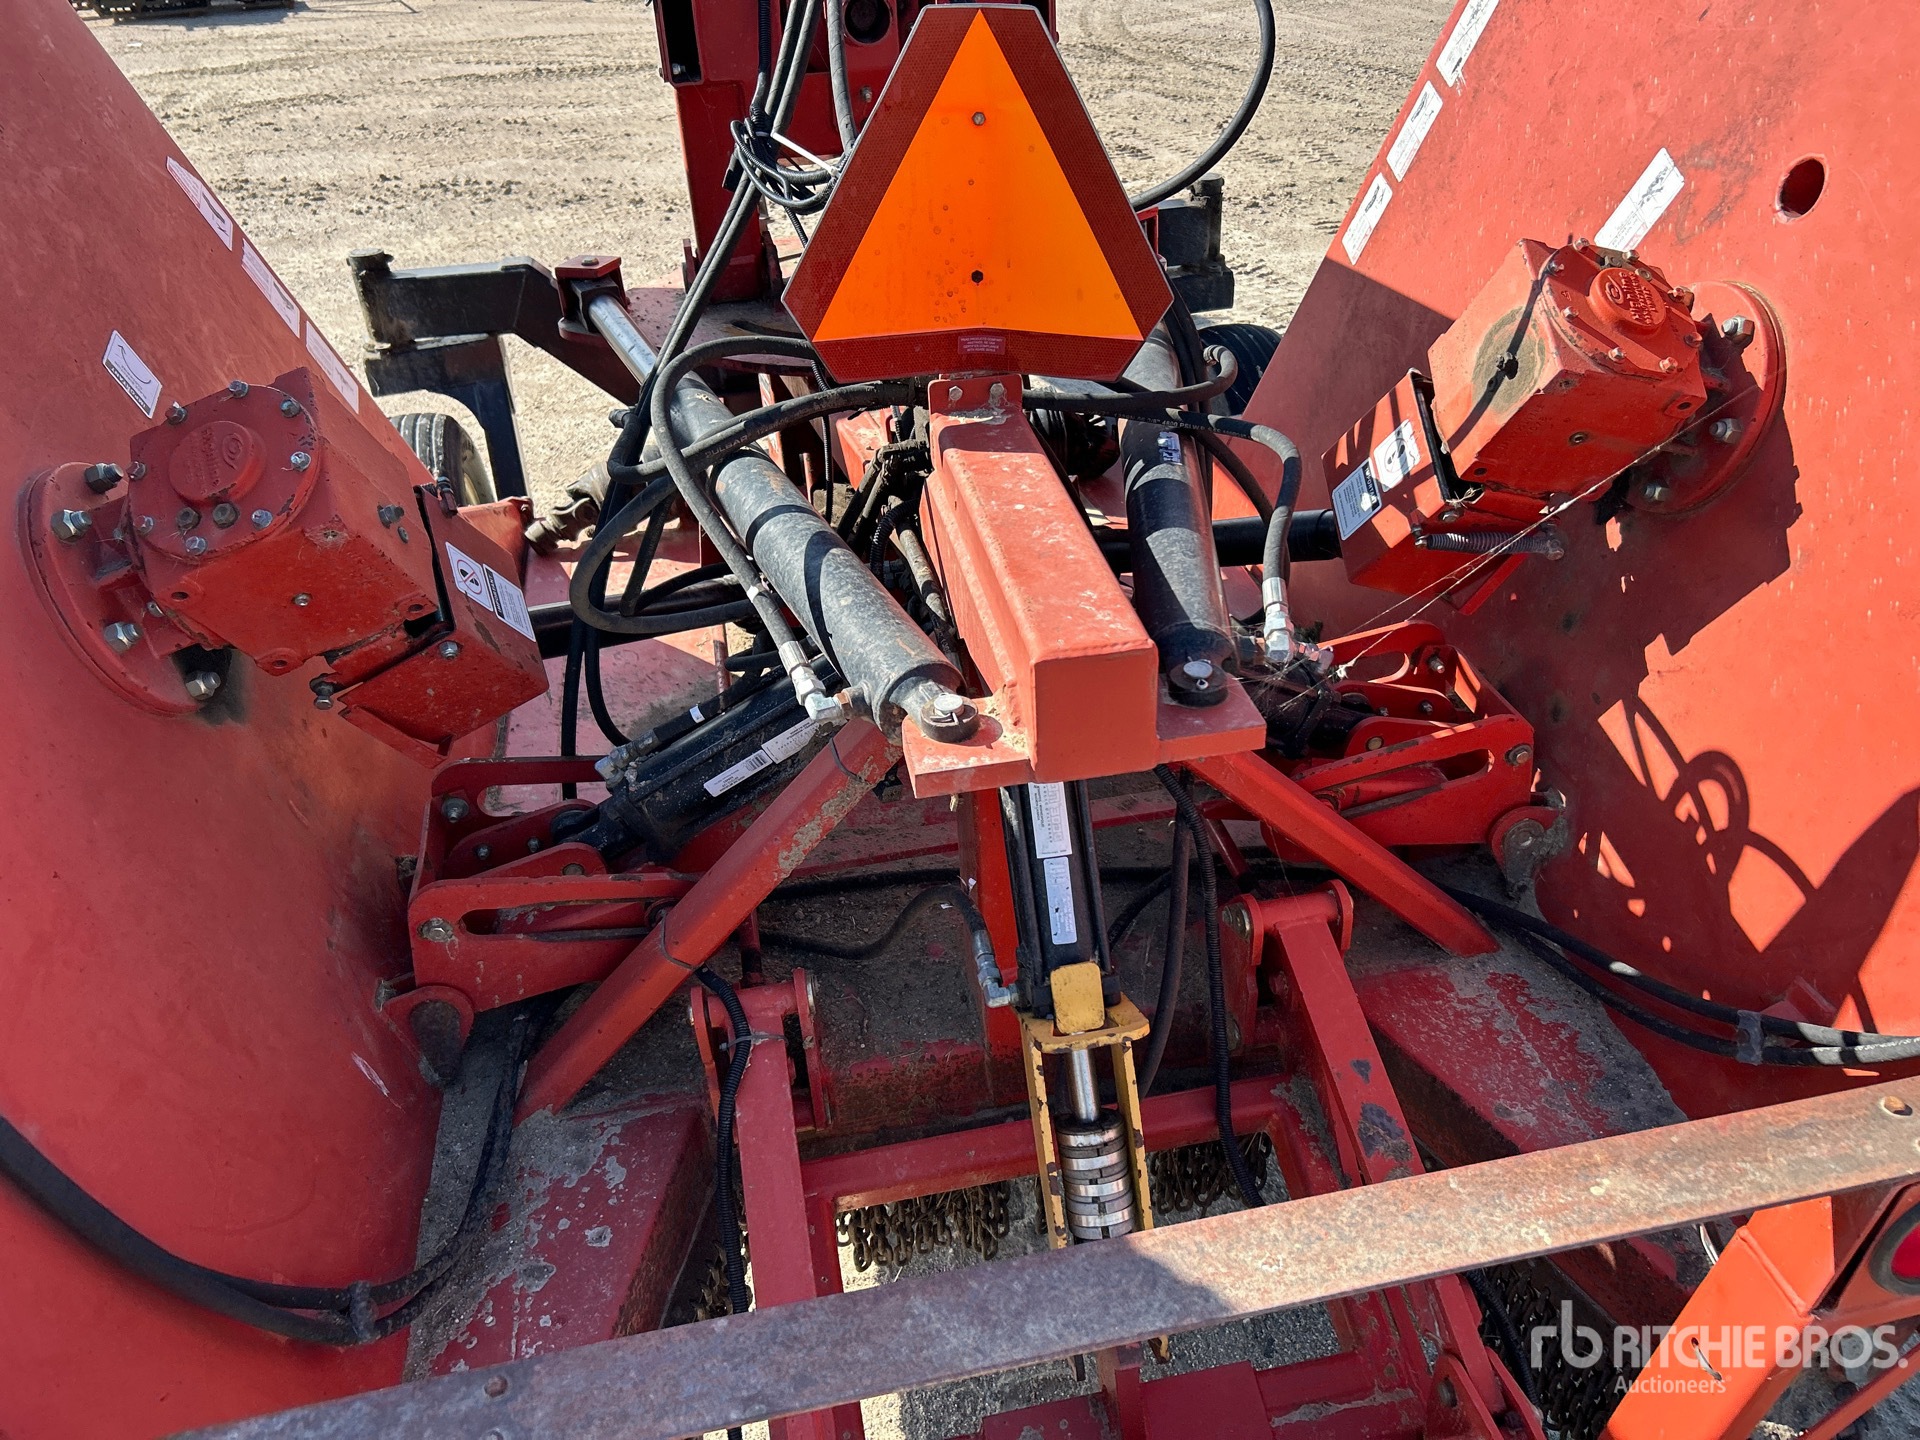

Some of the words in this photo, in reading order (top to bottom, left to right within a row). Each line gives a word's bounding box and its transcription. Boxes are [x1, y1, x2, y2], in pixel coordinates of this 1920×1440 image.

[110, 366, 146, 408] IMPORTANT
[1364, 467, 1377, 504] IMPORTANT
[488, 574, 501, 613] IMPORTANT
